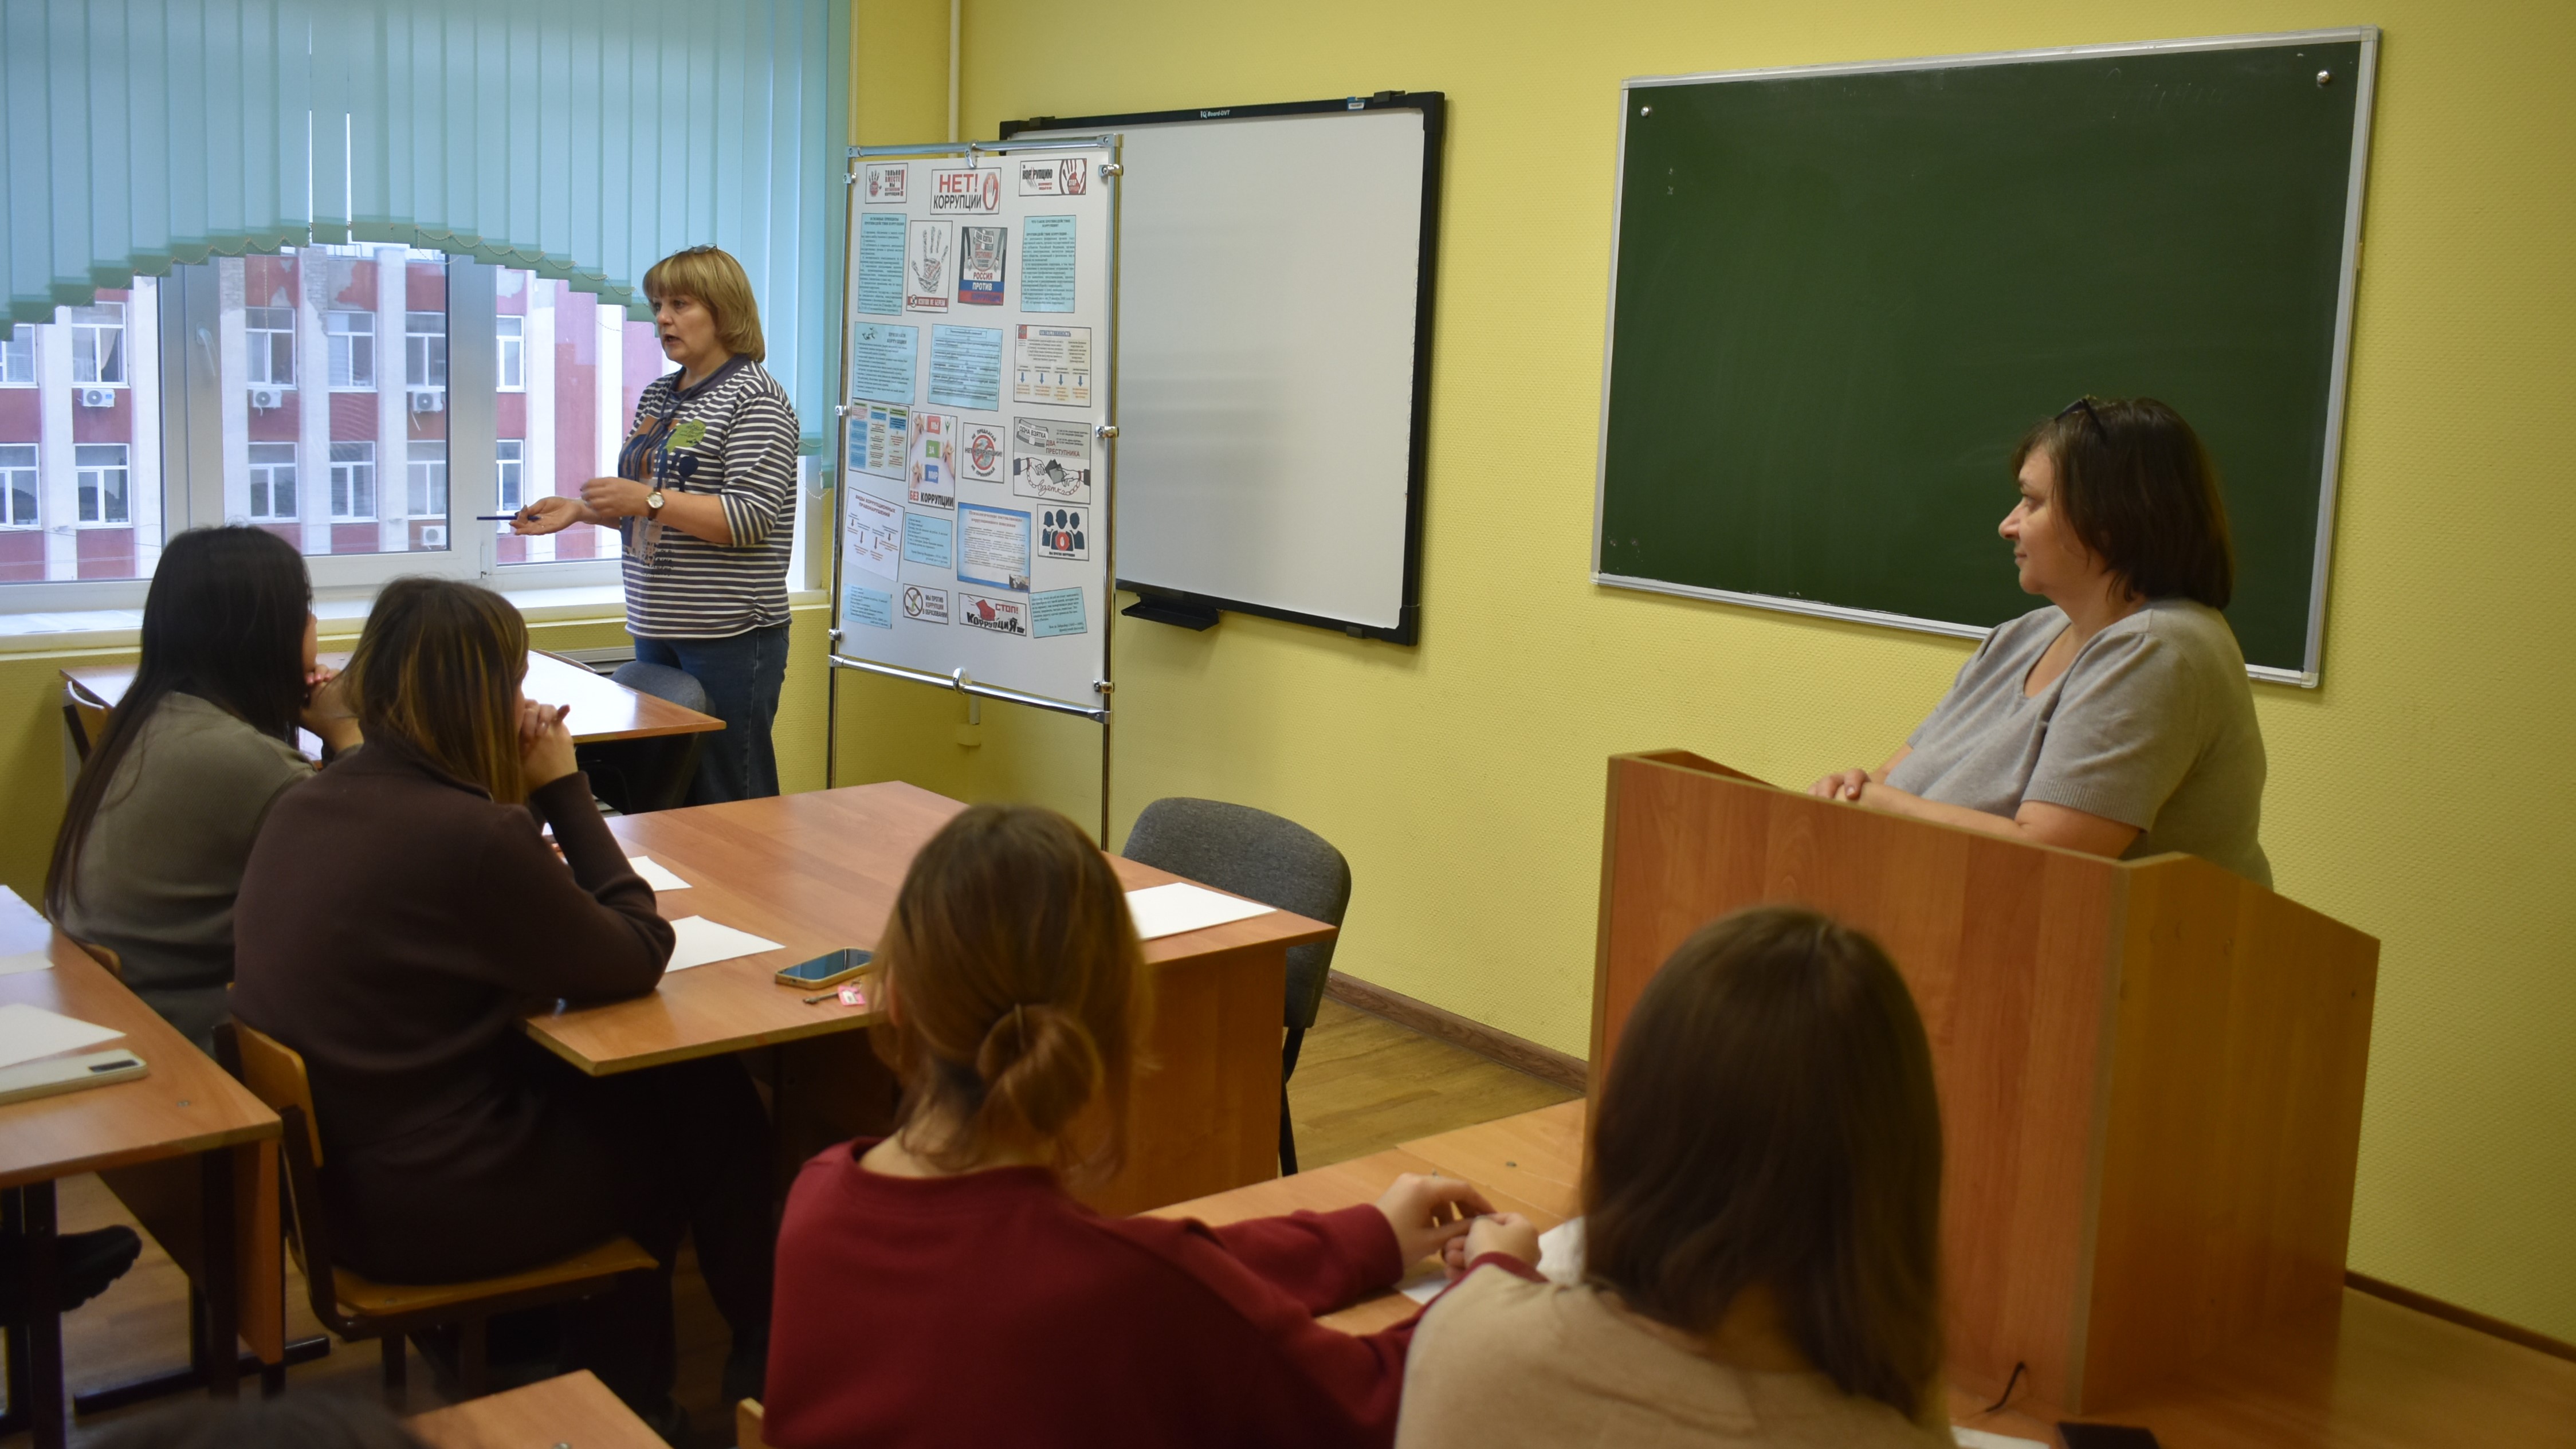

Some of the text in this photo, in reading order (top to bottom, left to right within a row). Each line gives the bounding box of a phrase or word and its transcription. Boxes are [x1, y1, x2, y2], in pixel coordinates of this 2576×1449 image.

[939, 174, 978, 193] НЕТ!
[933, 194, 981, 211] КОРРУПЦИИ
[973, 272, 992, 280] РОССИЯ
[972, 282, 992, 290] ПРОТИВ
[930, 422, 938, 430] МЫ
[1019, 426, 1030, 434] ОДНА
[1031, 430, 1046, 439] ВЗЯТКА
[929, 446, 934, 454] ЗА
[1046, 448, 1080, 457] ПРЕСТУПНИКА
[928, 470, 938, 480] МИР
[910, 490, 953, 508] БЕЗ КОРРУПЦИИ
[925, 602, 944, 610] КОРРУПЦИИ
[995, 603, 1018, 614] СТОП!
